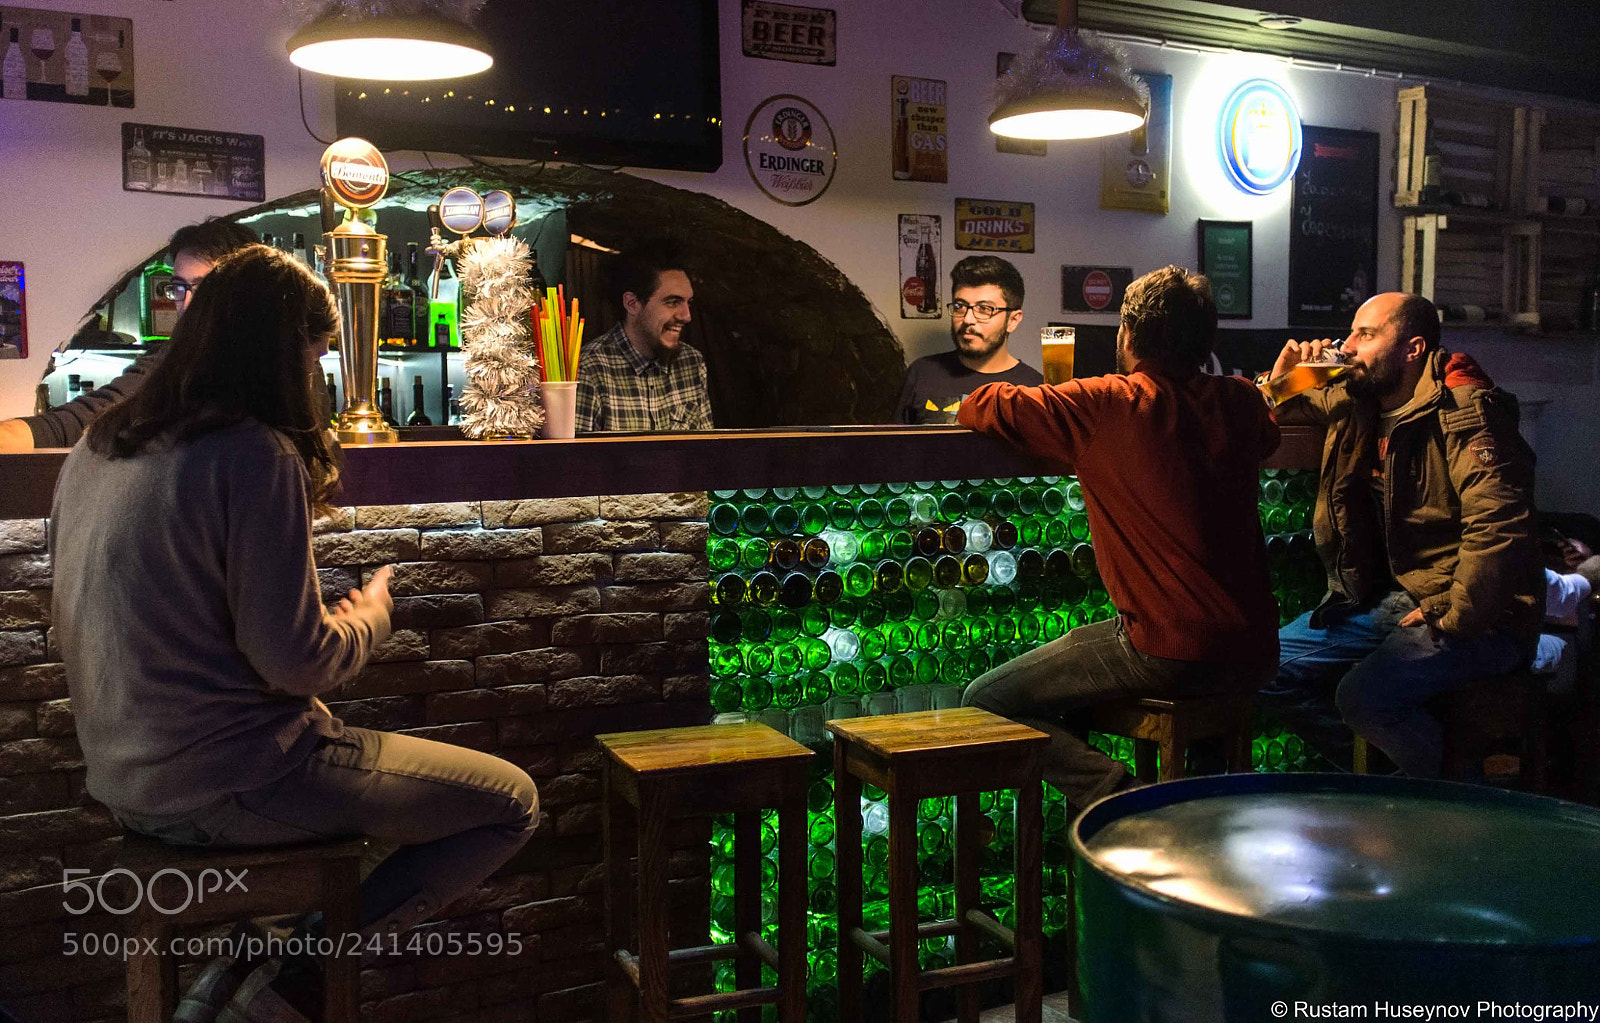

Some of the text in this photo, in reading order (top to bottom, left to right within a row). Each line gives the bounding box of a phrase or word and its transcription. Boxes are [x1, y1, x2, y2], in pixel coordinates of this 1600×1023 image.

[752, 21, 825, 46] BEER
[910, 81, 945, 106] BEER
[178, 133, 223, 145] JACK'S
[910, 131, 945, 151] GAS
[760, 153, 825, 176] ERDINGER
[964, 220, 1024, 234] DRINKS
